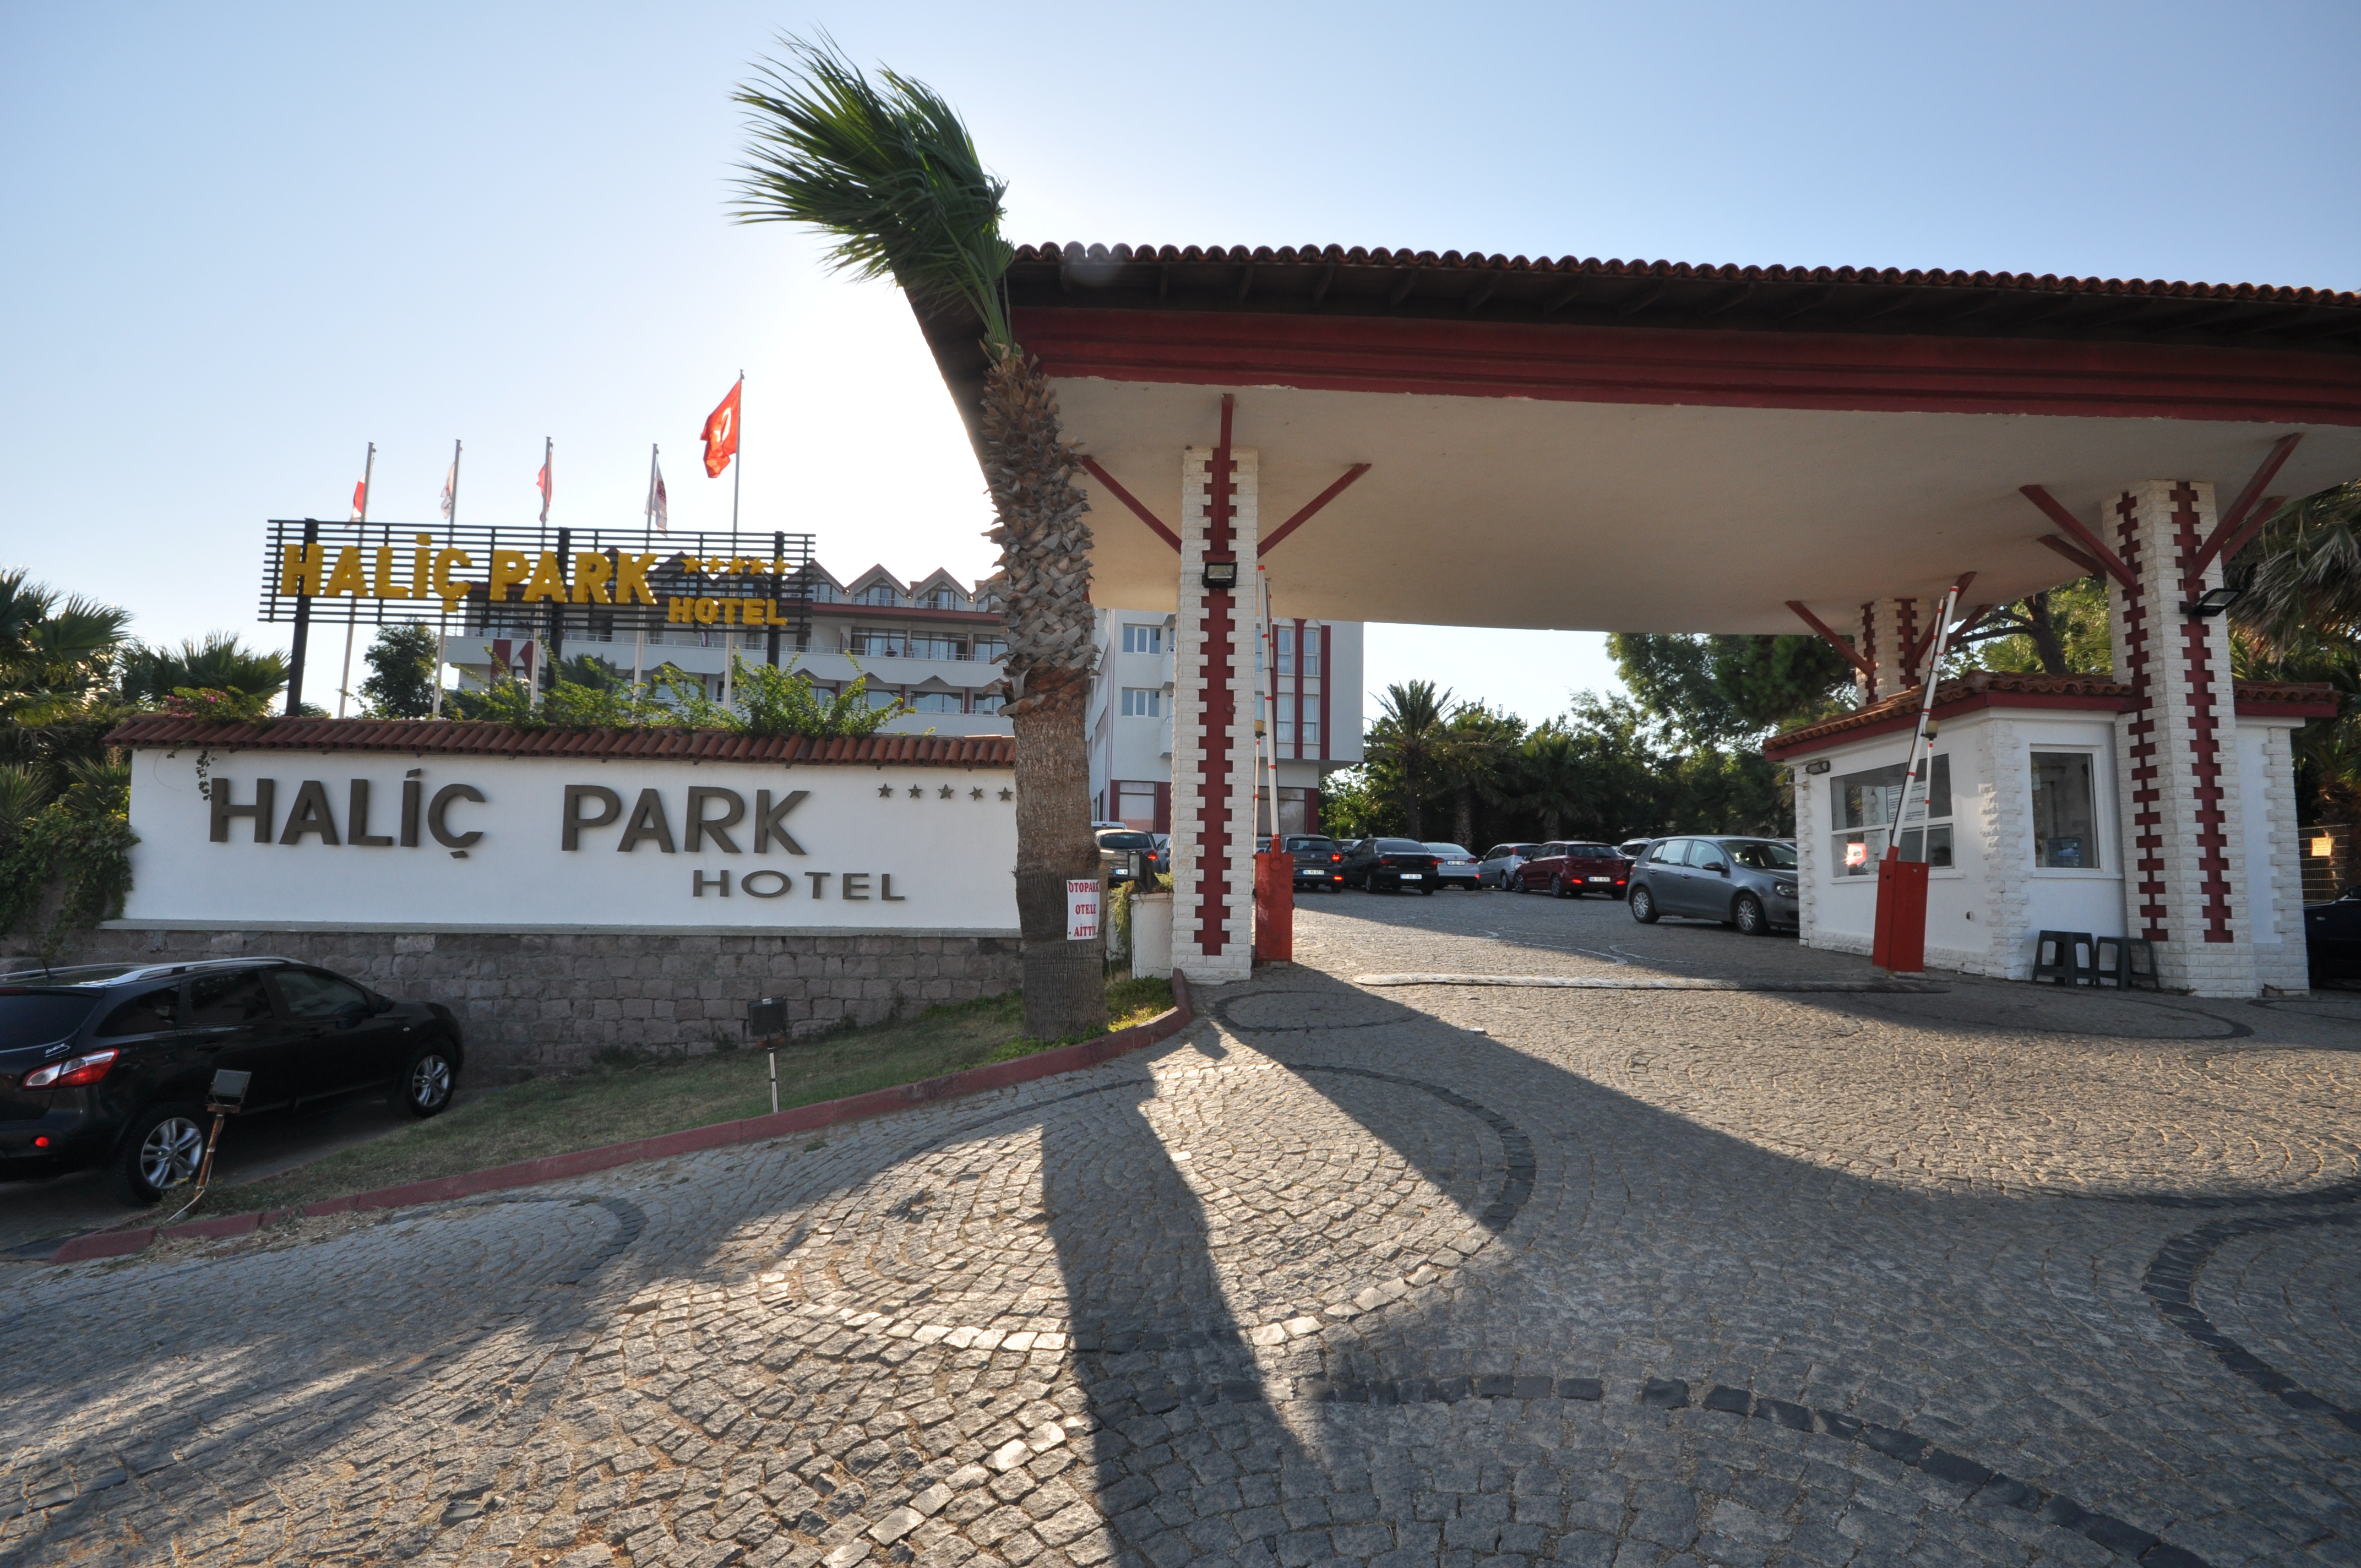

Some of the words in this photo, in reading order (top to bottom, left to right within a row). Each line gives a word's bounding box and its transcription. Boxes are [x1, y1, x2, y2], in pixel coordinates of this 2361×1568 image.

[280, 532, 472, 613] HALİÇ
[489, 548, 658, 605] PARK
[668, 595, 788, 625] HOTEL
[209, 768, 486, 859] HALİÇ
[561, 784, 810, 856] PARK
[692, 869, 906, 901] HOTEL
[1069, 881, 1100, 893] OTOPARK
[1075, 903, 1096, 915] OTELE
